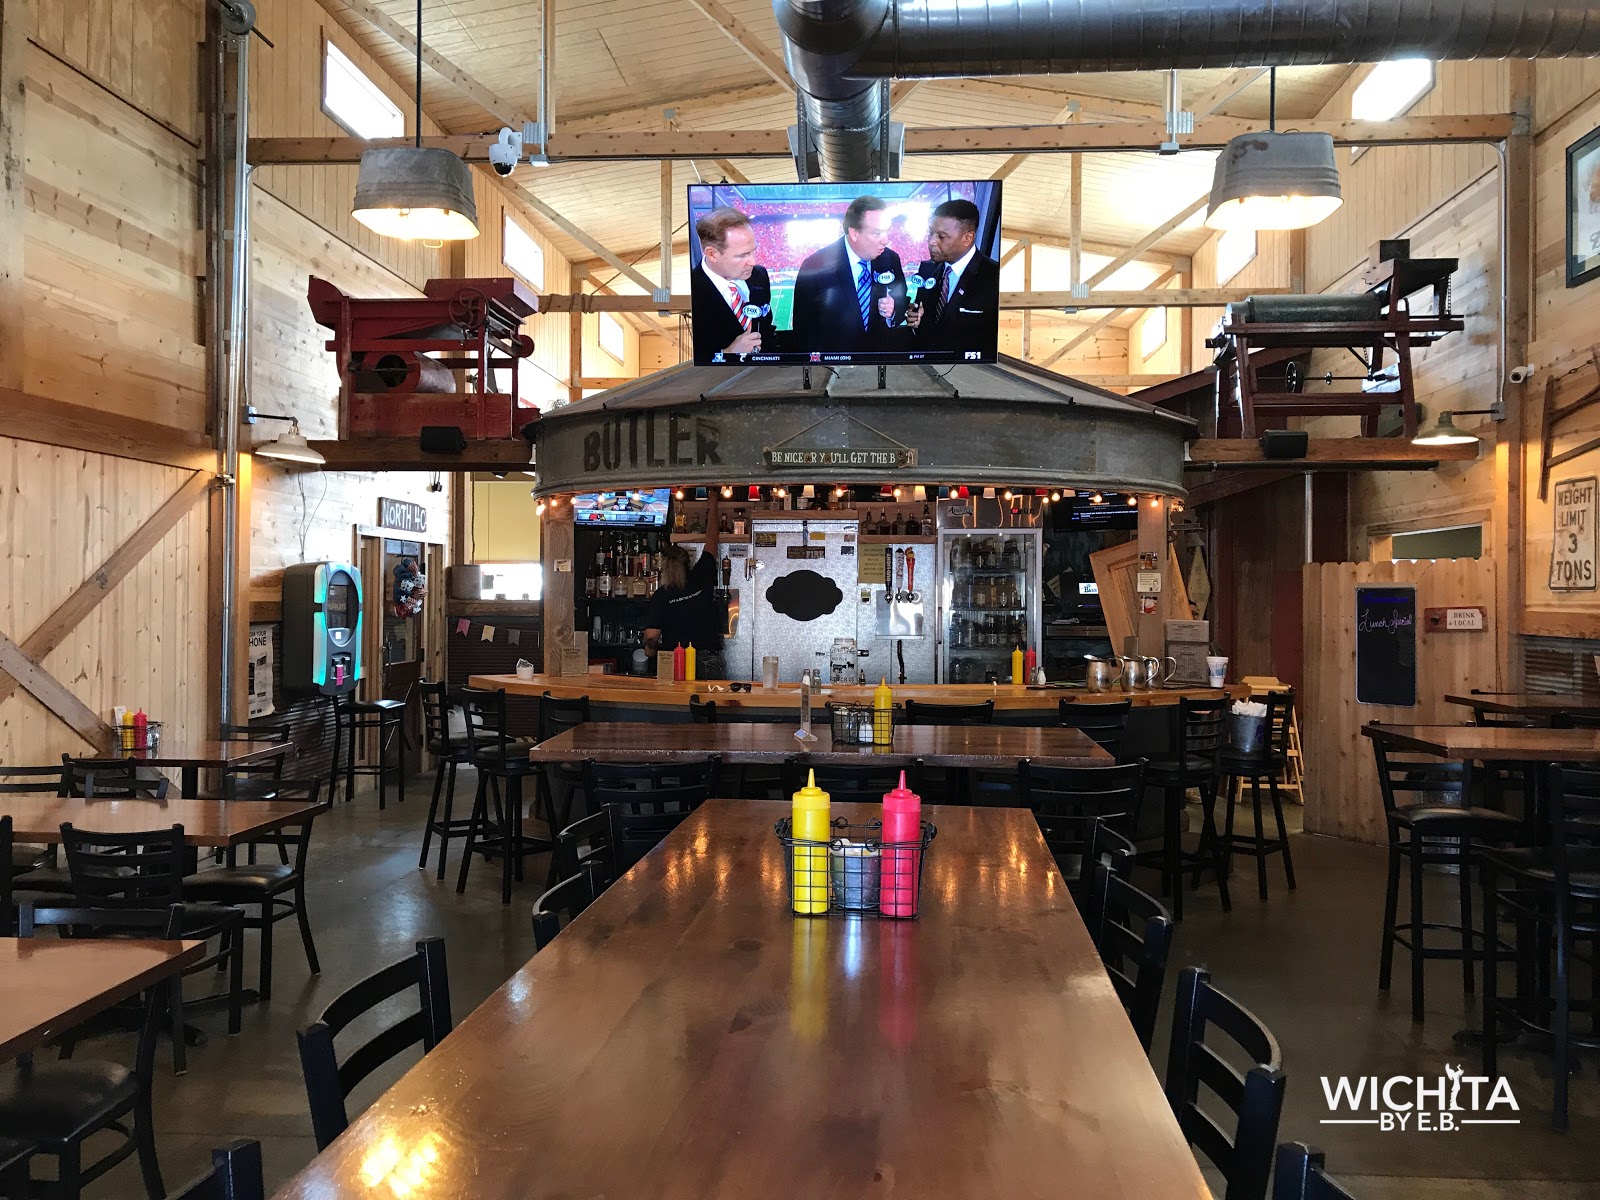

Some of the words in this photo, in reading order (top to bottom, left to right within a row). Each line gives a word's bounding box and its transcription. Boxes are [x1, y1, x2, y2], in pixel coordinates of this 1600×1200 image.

[964, 351, 981, 360] FS1
[583, 411, 722, 472] BUTLER
[771, 452, 783, 463] BE
[784, 452, 804, 464] NICE
[819, 452, 849, 464] YU'LL
[850, 452, 867, 464] GET
[870, 452, 888, 464] THE
[1558, 486, 1593, 507] WEIGHT
[382, 499, 412, 530] NORTH
[1560, 509, 1586, 527] LIMIT
[1567, 532, 1578, 553] 3
[1556, 560, 1592, 581] TONS
[1358, 608, 1387, 632] Lunch
[1387, 610, 1413, 634] Special
